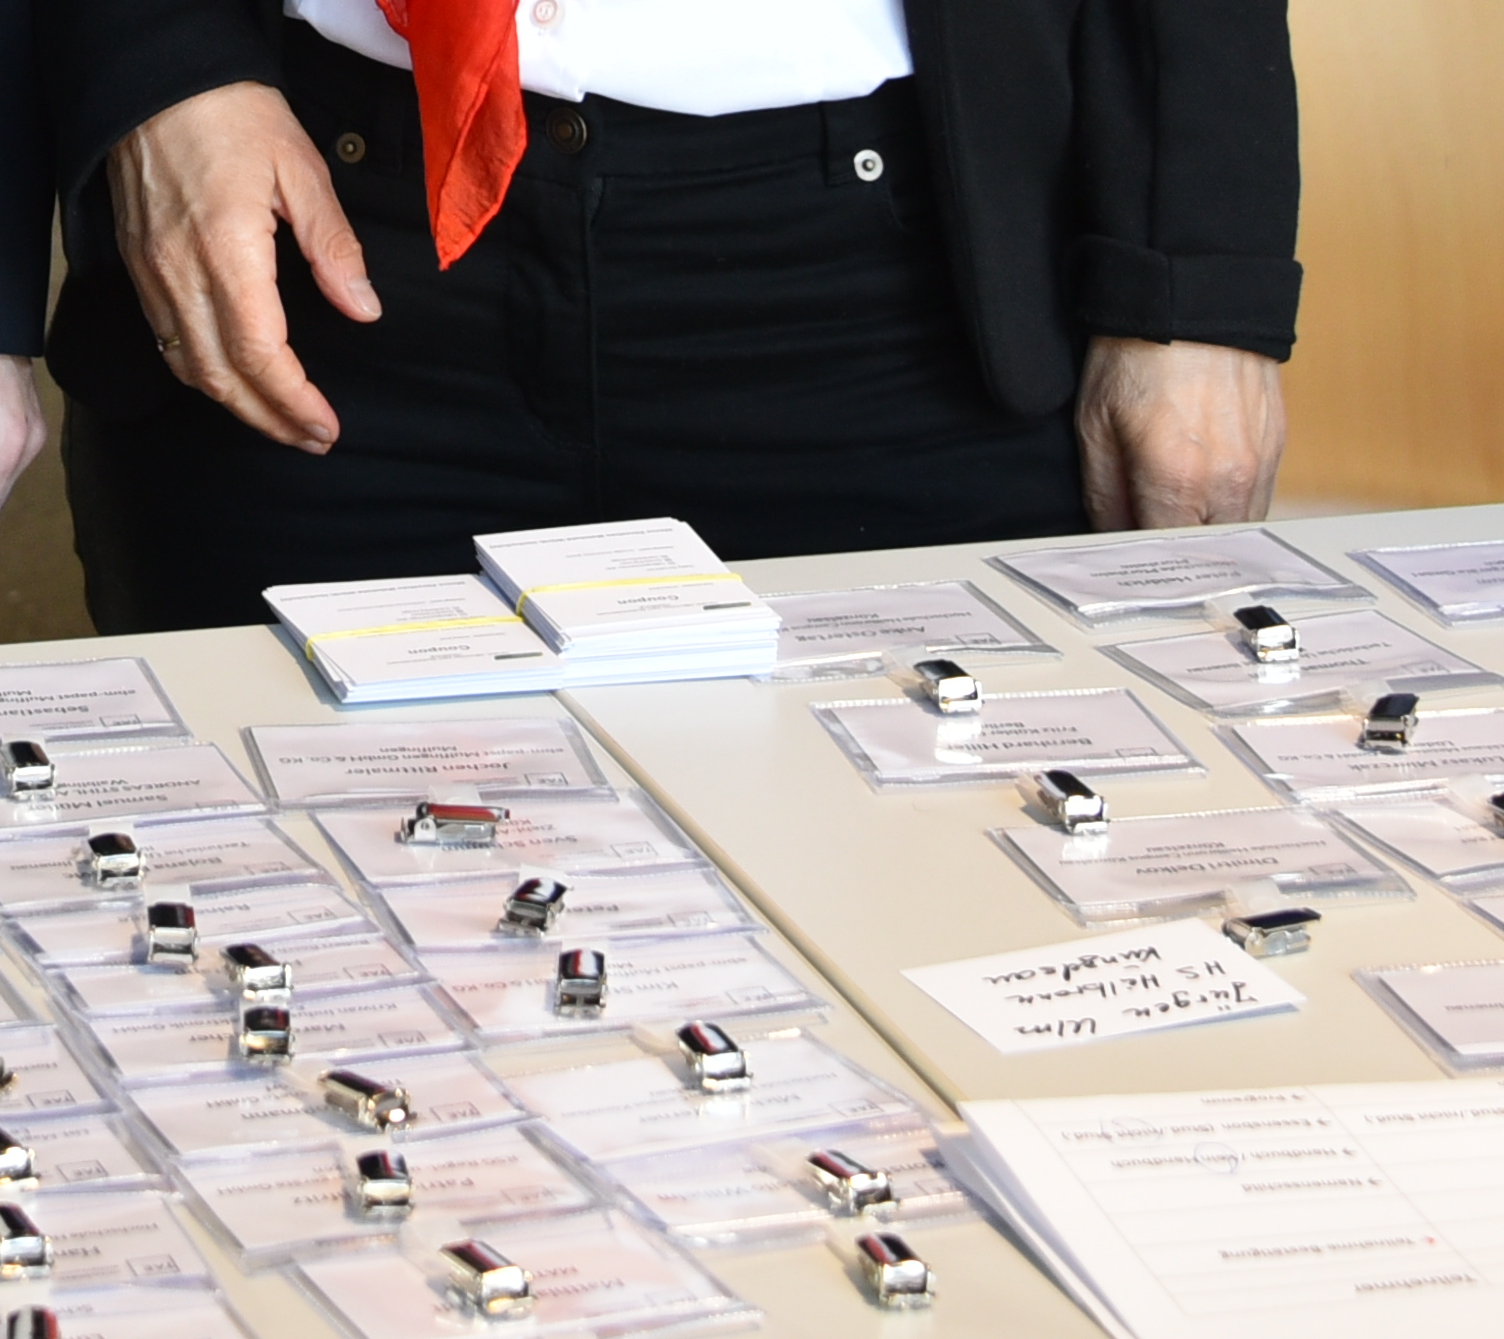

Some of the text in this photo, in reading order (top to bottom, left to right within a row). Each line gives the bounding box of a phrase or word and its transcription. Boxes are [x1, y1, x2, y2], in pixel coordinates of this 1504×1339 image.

[617, 594, 679, 606] Coupon
[794, 626, 926, 643] Anke Ostertag
[408, 644, 471, 657] Coupon
[1300, 658, 1369, 673] Thomas
[1043, 726, 1078, 737] Fritz
[378, 744, 458, 754] Mulfingen
[483, 747, 564, 757] ebm-papst
[945, 737, 1093, 753] Bernhard Hiller
[347, 753, 399, 763] GmbH
[400, 750, 480, 762] Mulfingen
[344, 761, 511, 778] Jochen Rittmaier
[123, 777, 200, 792] ANDREAS
[97, 789, 168, 803] Samuel
[529, 835, 578, 847] Sven
[153, 857, 223, 872] Bojana
[1135, 856, 1280, 877] Dimitri Delkov
[1174, 960, 1227, 980] HS
[638, 979, 679, 991] Kim
[1012, 982, 1259, 1038] Jürgen Ulm
[1200, 1093, 1288, 1106] Programm
[1220, 1116, 1314, 1134] Essensbon
[1109, 1146, 1339, 1173] Handbuch Handbuch
[1241, 1176, 1364, 1194] Namensschild
[1353, 1272, 1479, 1296] Teilnehmer
